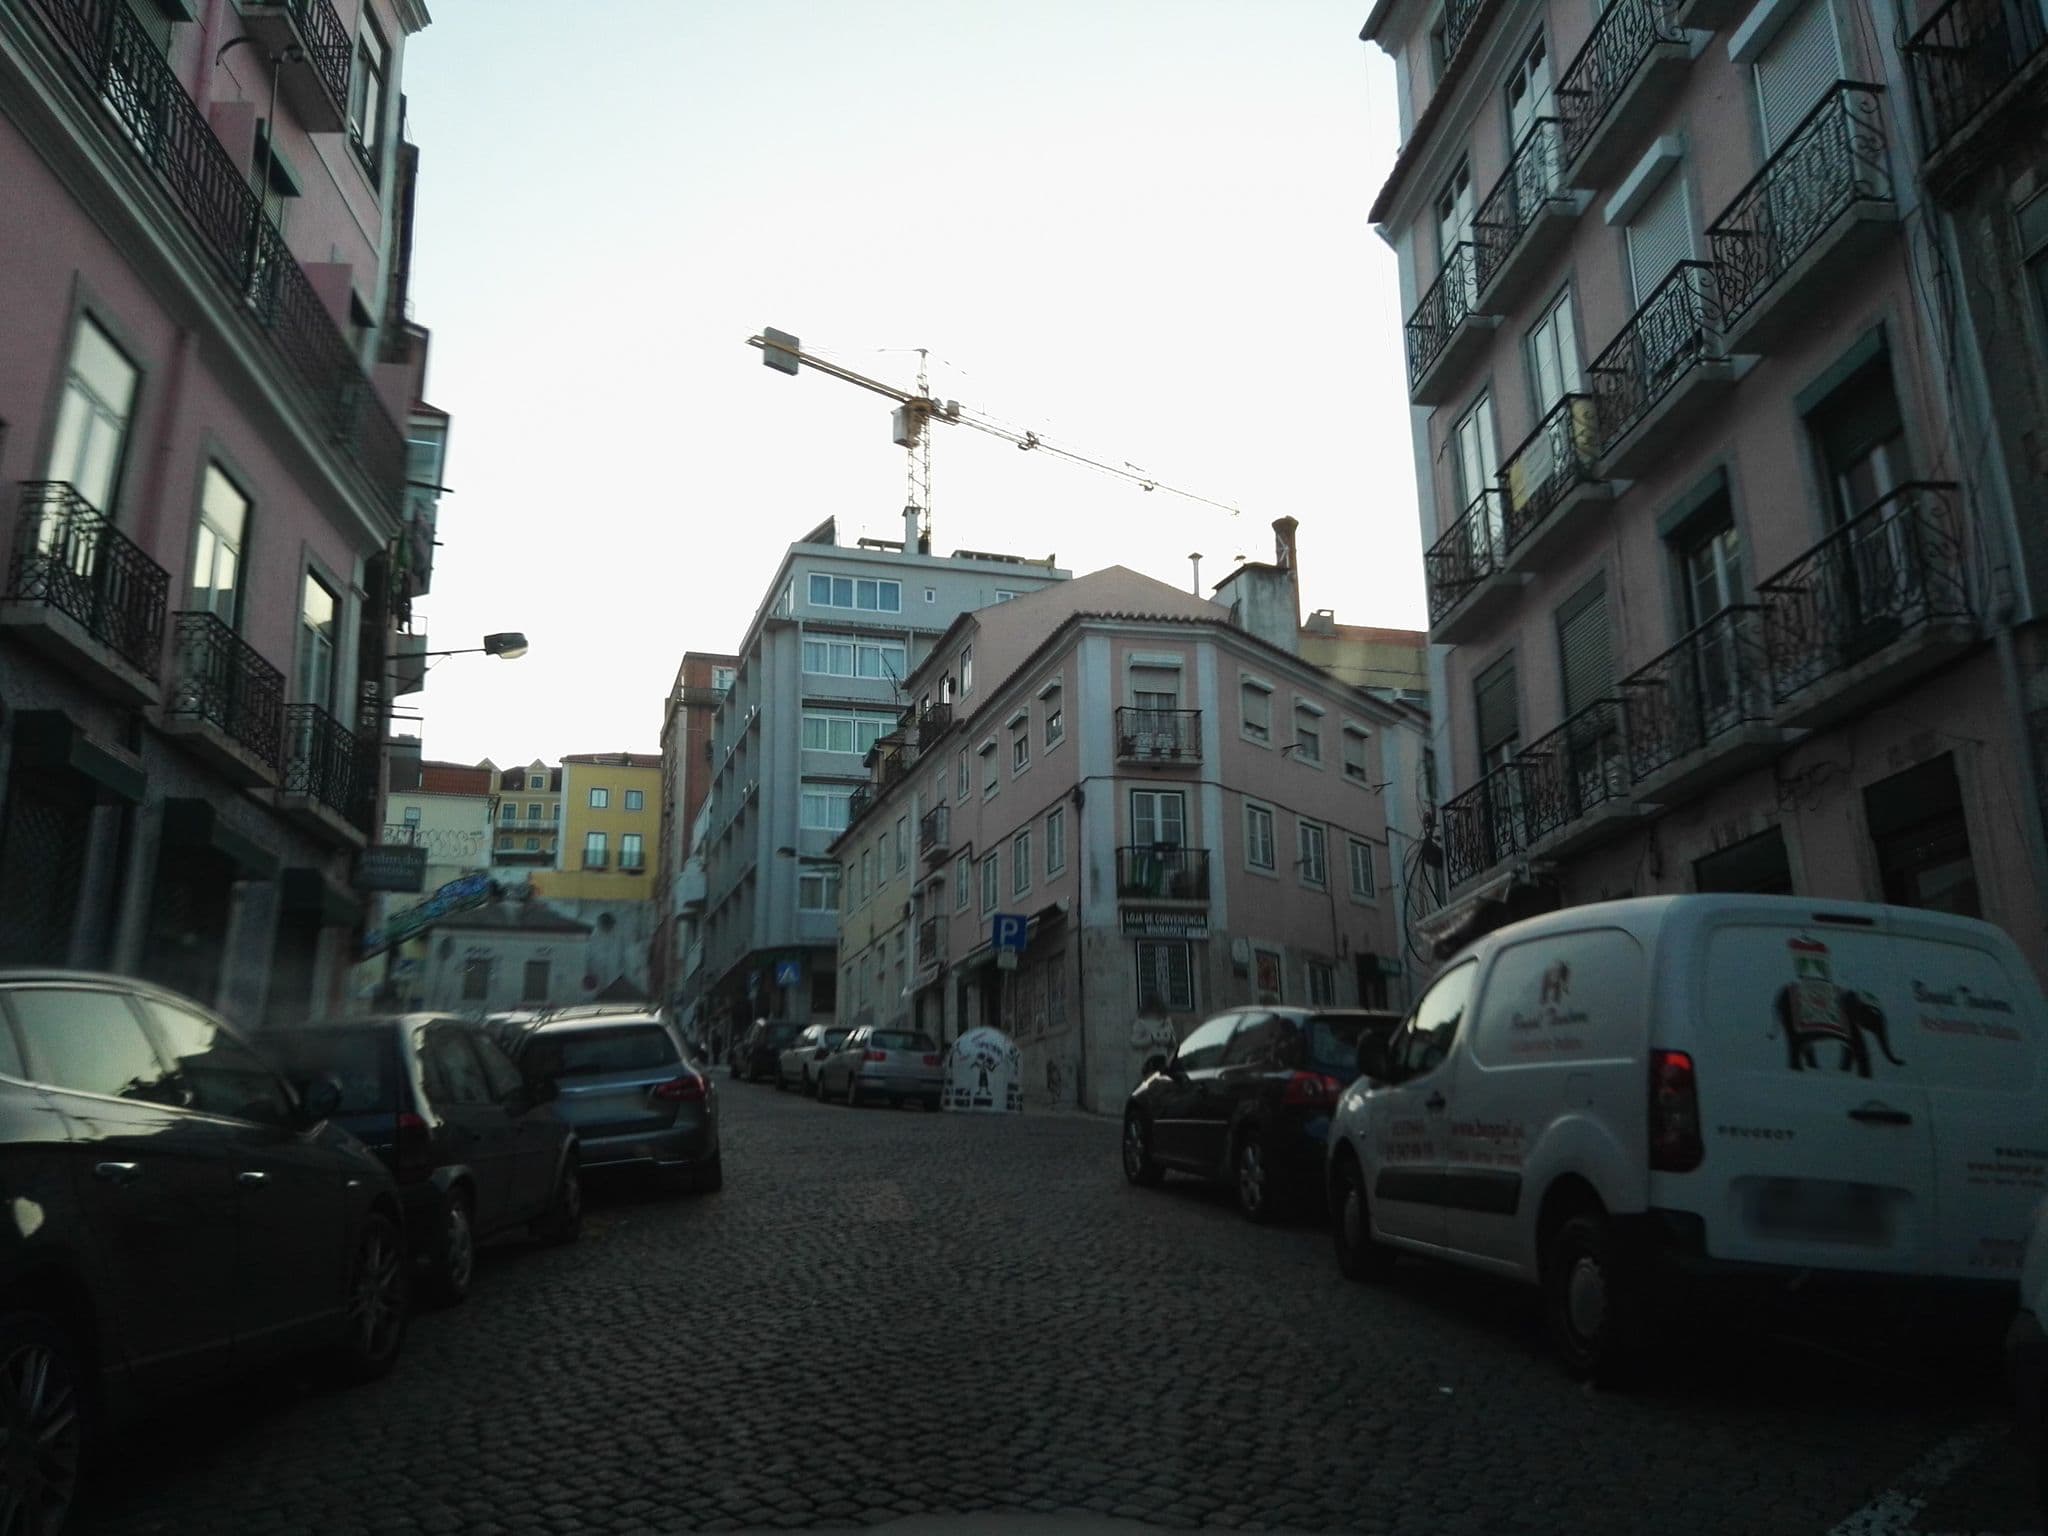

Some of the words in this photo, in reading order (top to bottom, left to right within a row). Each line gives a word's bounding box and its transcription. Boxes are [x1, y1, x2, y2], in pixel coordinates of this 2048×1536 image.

[1125, 912, 1143, 923] LOJA
[1144, 912, 1153, 923] DE
[999, 918, 1018, 946] P
[1717, 1126, 1794, 1138] PEUGEOT
